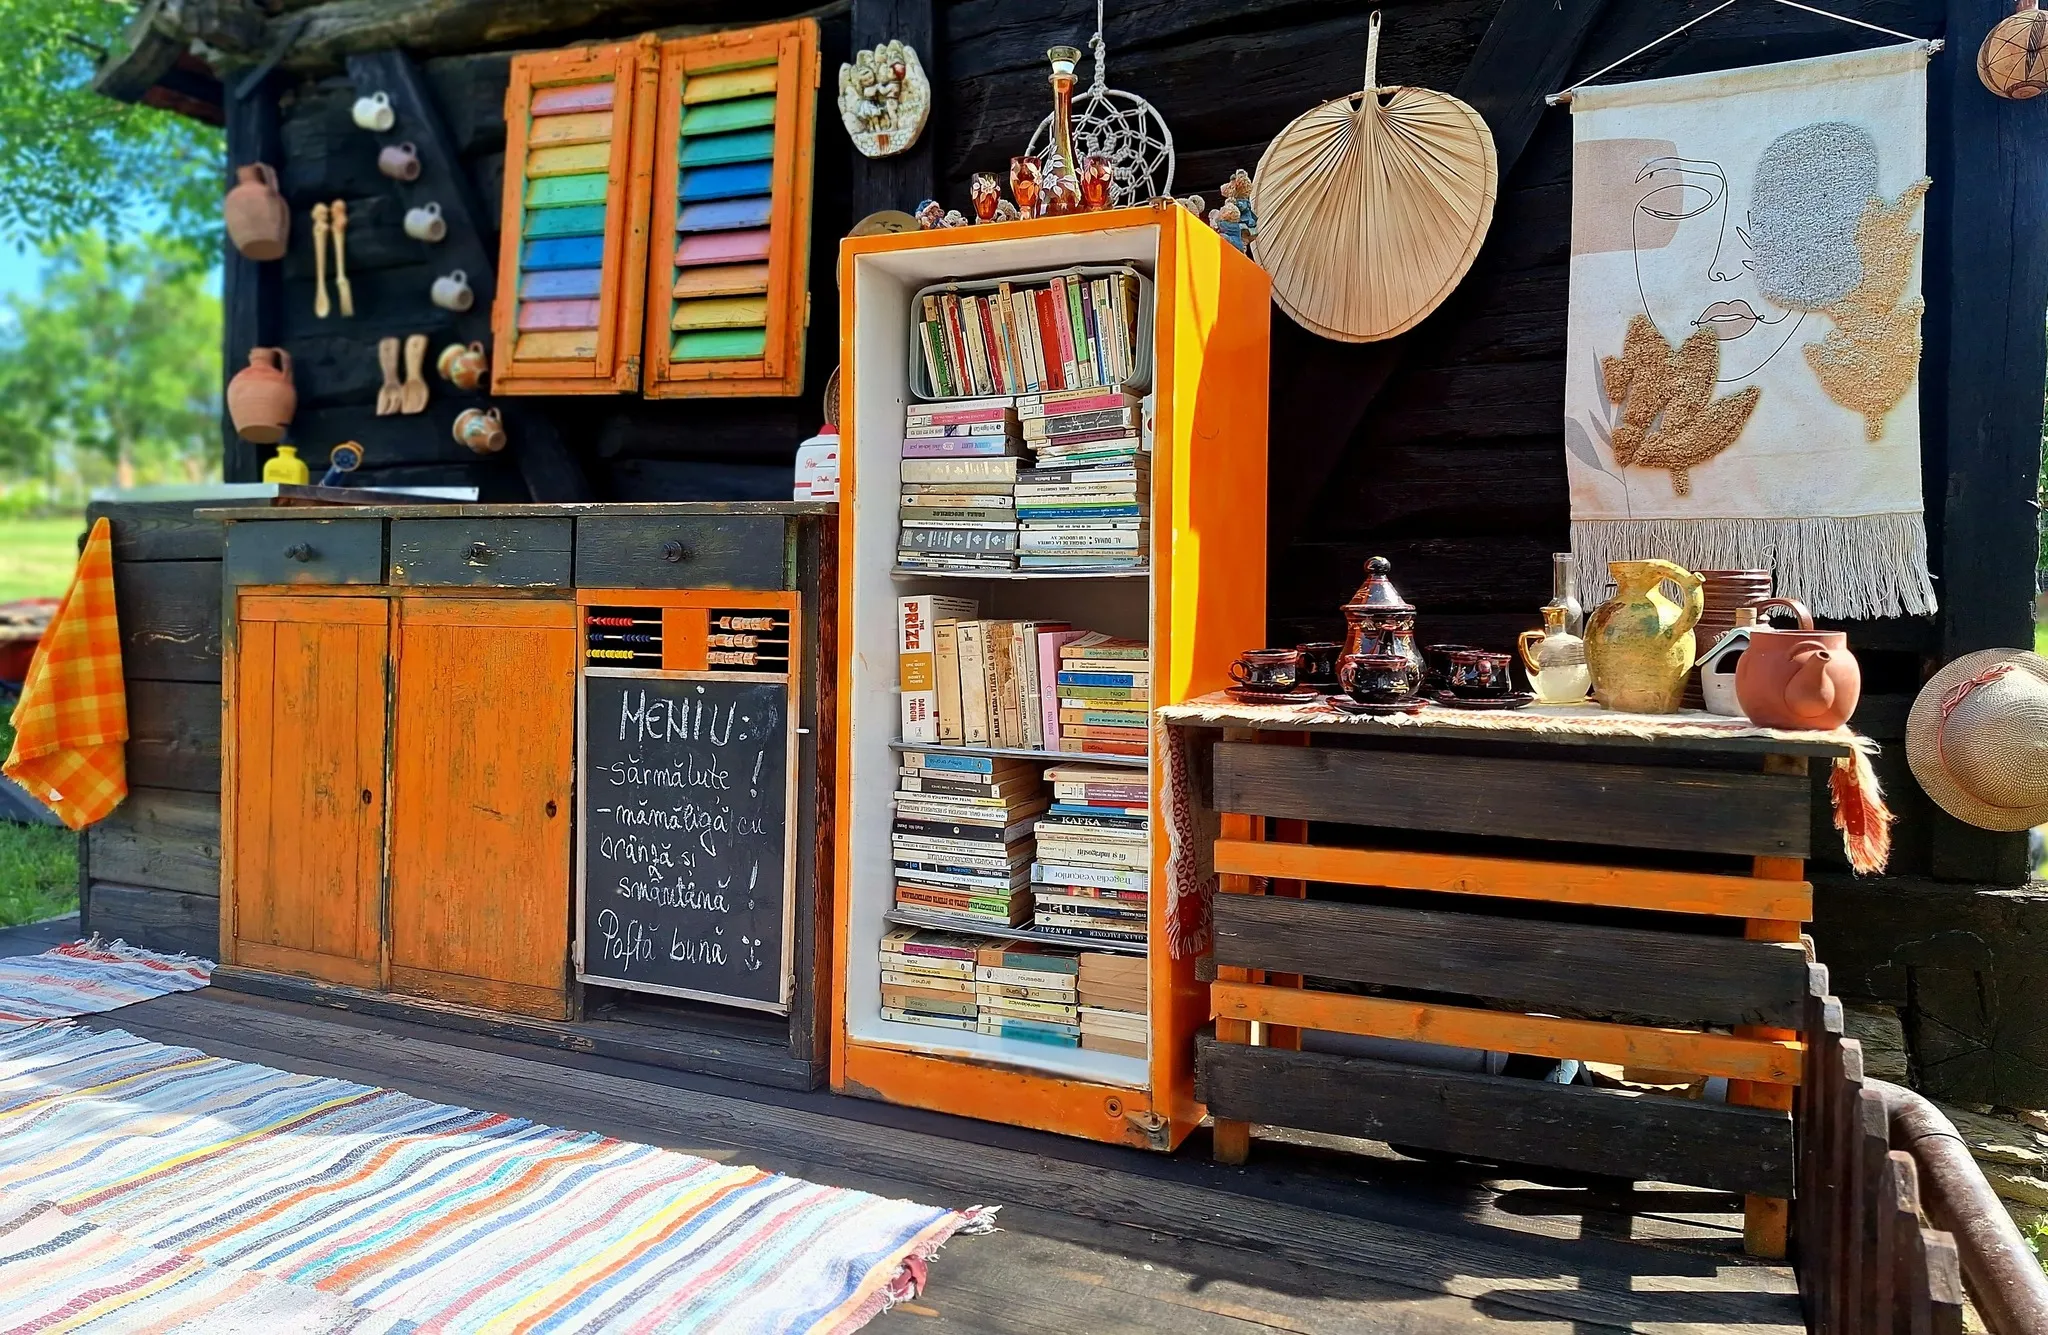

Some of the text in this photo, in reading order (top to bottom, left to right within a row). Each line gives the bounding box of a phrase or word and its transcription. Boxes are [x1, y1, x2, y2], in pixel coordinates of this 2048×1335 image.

[904, 602, 920, 650] PRIZE
[619, 686, 750, 746] MENIU:
[738, 815, 766, 836] cu
[1061, 816, 1102, 826] KAFKA
[1097, 876, 1132, 886] Tragedia
[1041, 927, 1072, 935] BANZAI
[598, 908, 728, 973] Poftă bună
[1017, 975, 1045, 983] rousseau
